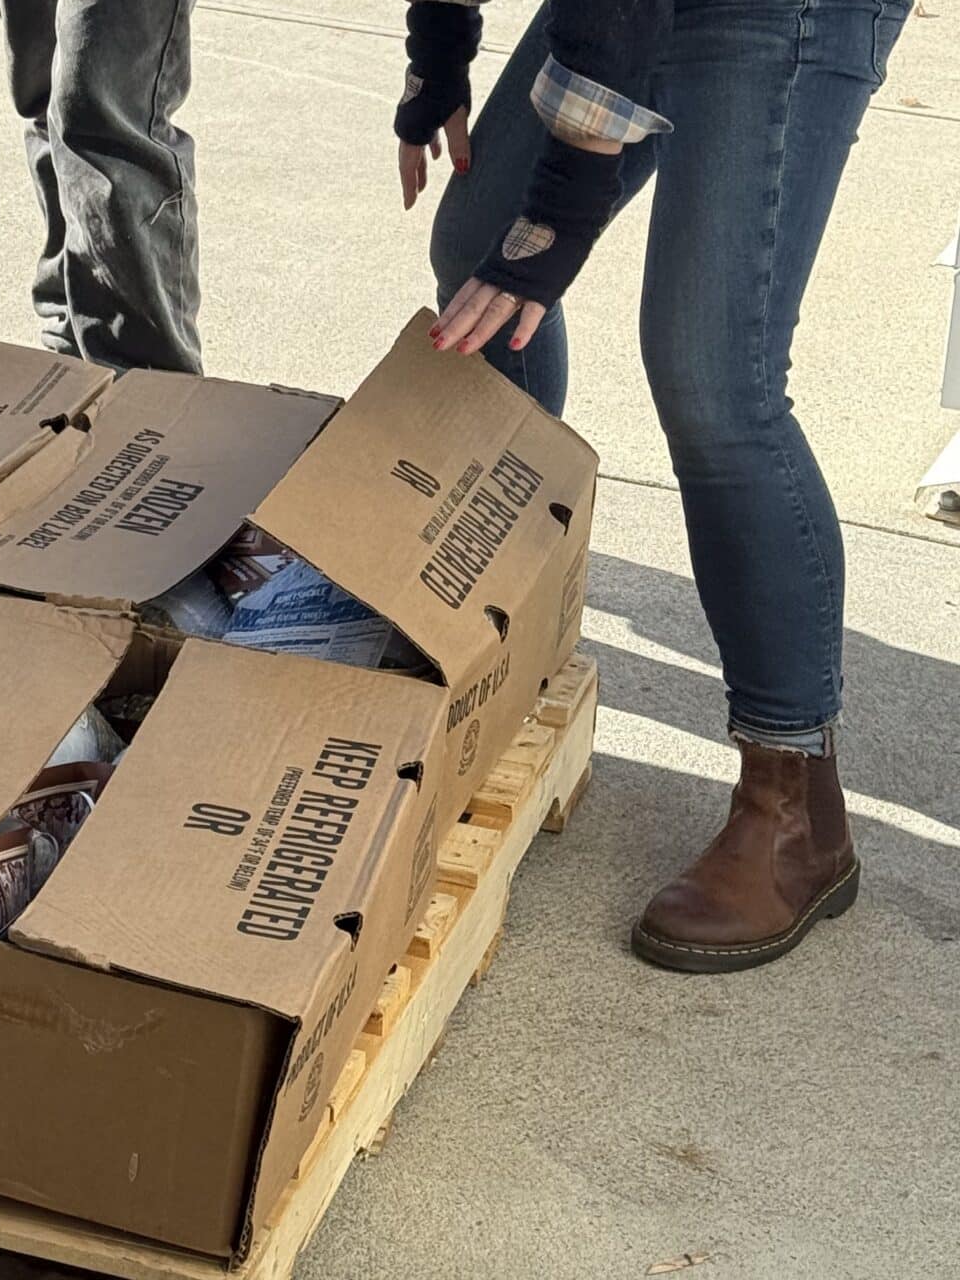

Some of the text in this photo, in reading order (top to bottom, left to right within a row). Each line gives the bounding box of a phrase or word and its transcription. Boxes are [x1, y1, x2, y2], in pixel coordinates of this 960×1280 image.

[16, 428, 165, 550] AS DIRECTED ON BOX LABEL
[390, 459, 441, 498] OR
[489, 449, 544, 508] KEEP
[114, 478, 205, 537] FROZEN
[420, 486, 519, 609] REFRIGERATED
[270, 767, 304, 806] (PREFERRED
[312, 737, 382, 790] KEEP
[183, 803, 251, 836] OR
[255, 827, 275, 839] OF
[237, 790, 359, 941] REFRIGERATED
